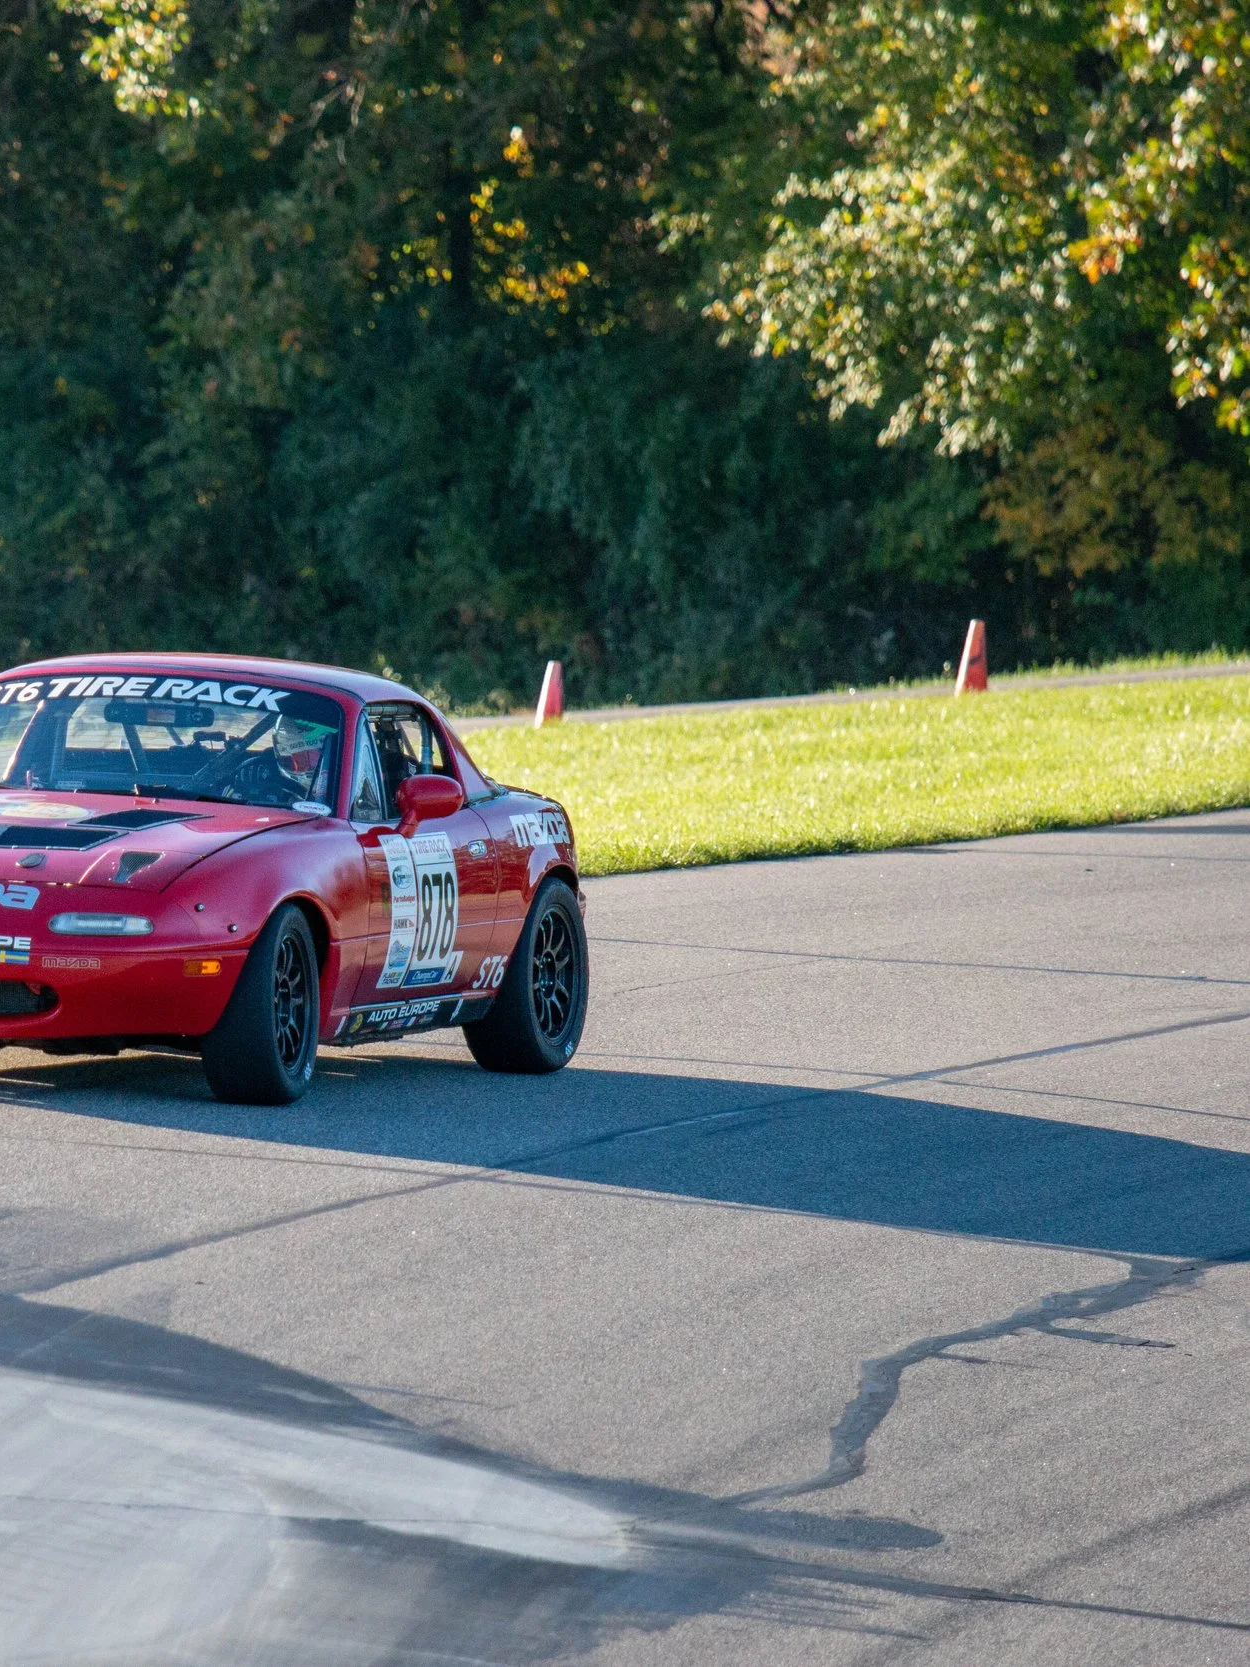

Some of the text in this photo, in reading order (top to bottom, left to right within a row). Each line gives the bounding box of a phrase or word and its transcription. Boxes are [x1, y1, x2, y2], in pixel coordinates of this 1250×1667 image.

[47, 676, 156, 698] TIRE
[151, 678, 291, 712] RACK
[412, 839, 428, 855] TIRE
[428, 838, 451, 858] RACK
[417, 871, 455, 962] 878
[472, 954, 508, 990] ST6
[367, 1000, 440, 1023] AUTO EUROPE
